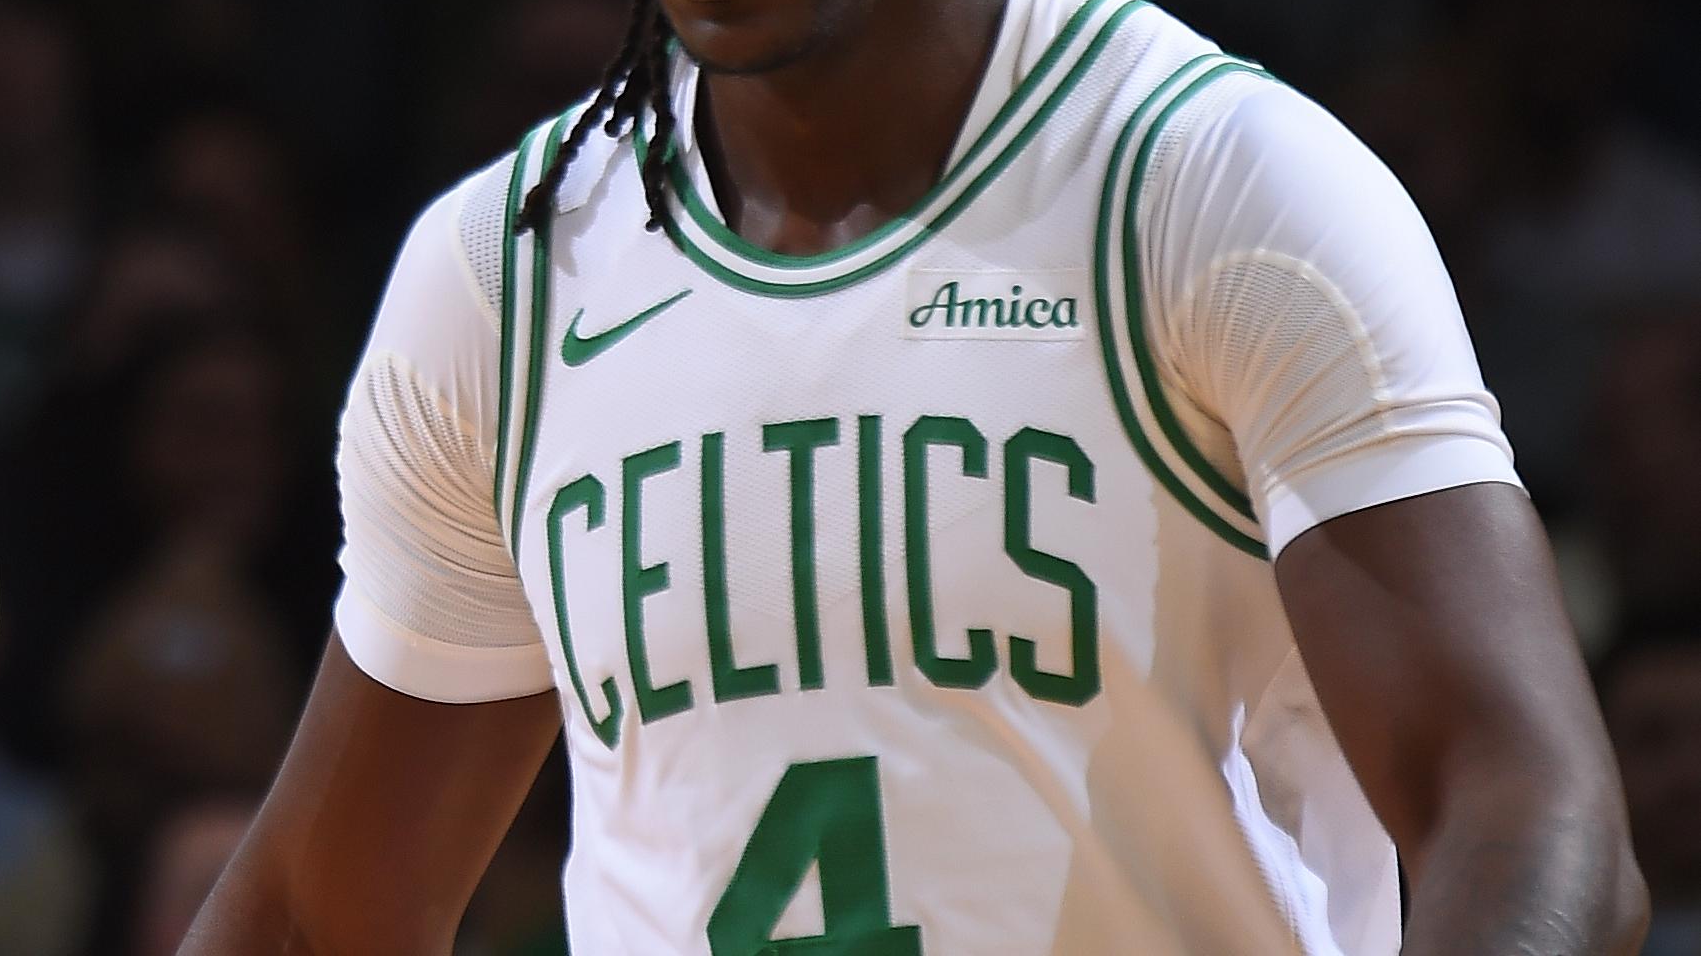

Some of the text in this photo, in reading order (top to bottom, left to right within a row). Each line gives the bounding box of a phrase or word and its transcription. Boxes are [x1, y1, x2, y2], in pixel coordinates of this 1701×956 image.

[910, 281, 1079, 328] Amica
[547, 414, 1099, 750] CELTICS
[706, 755, 923, 956] 4
